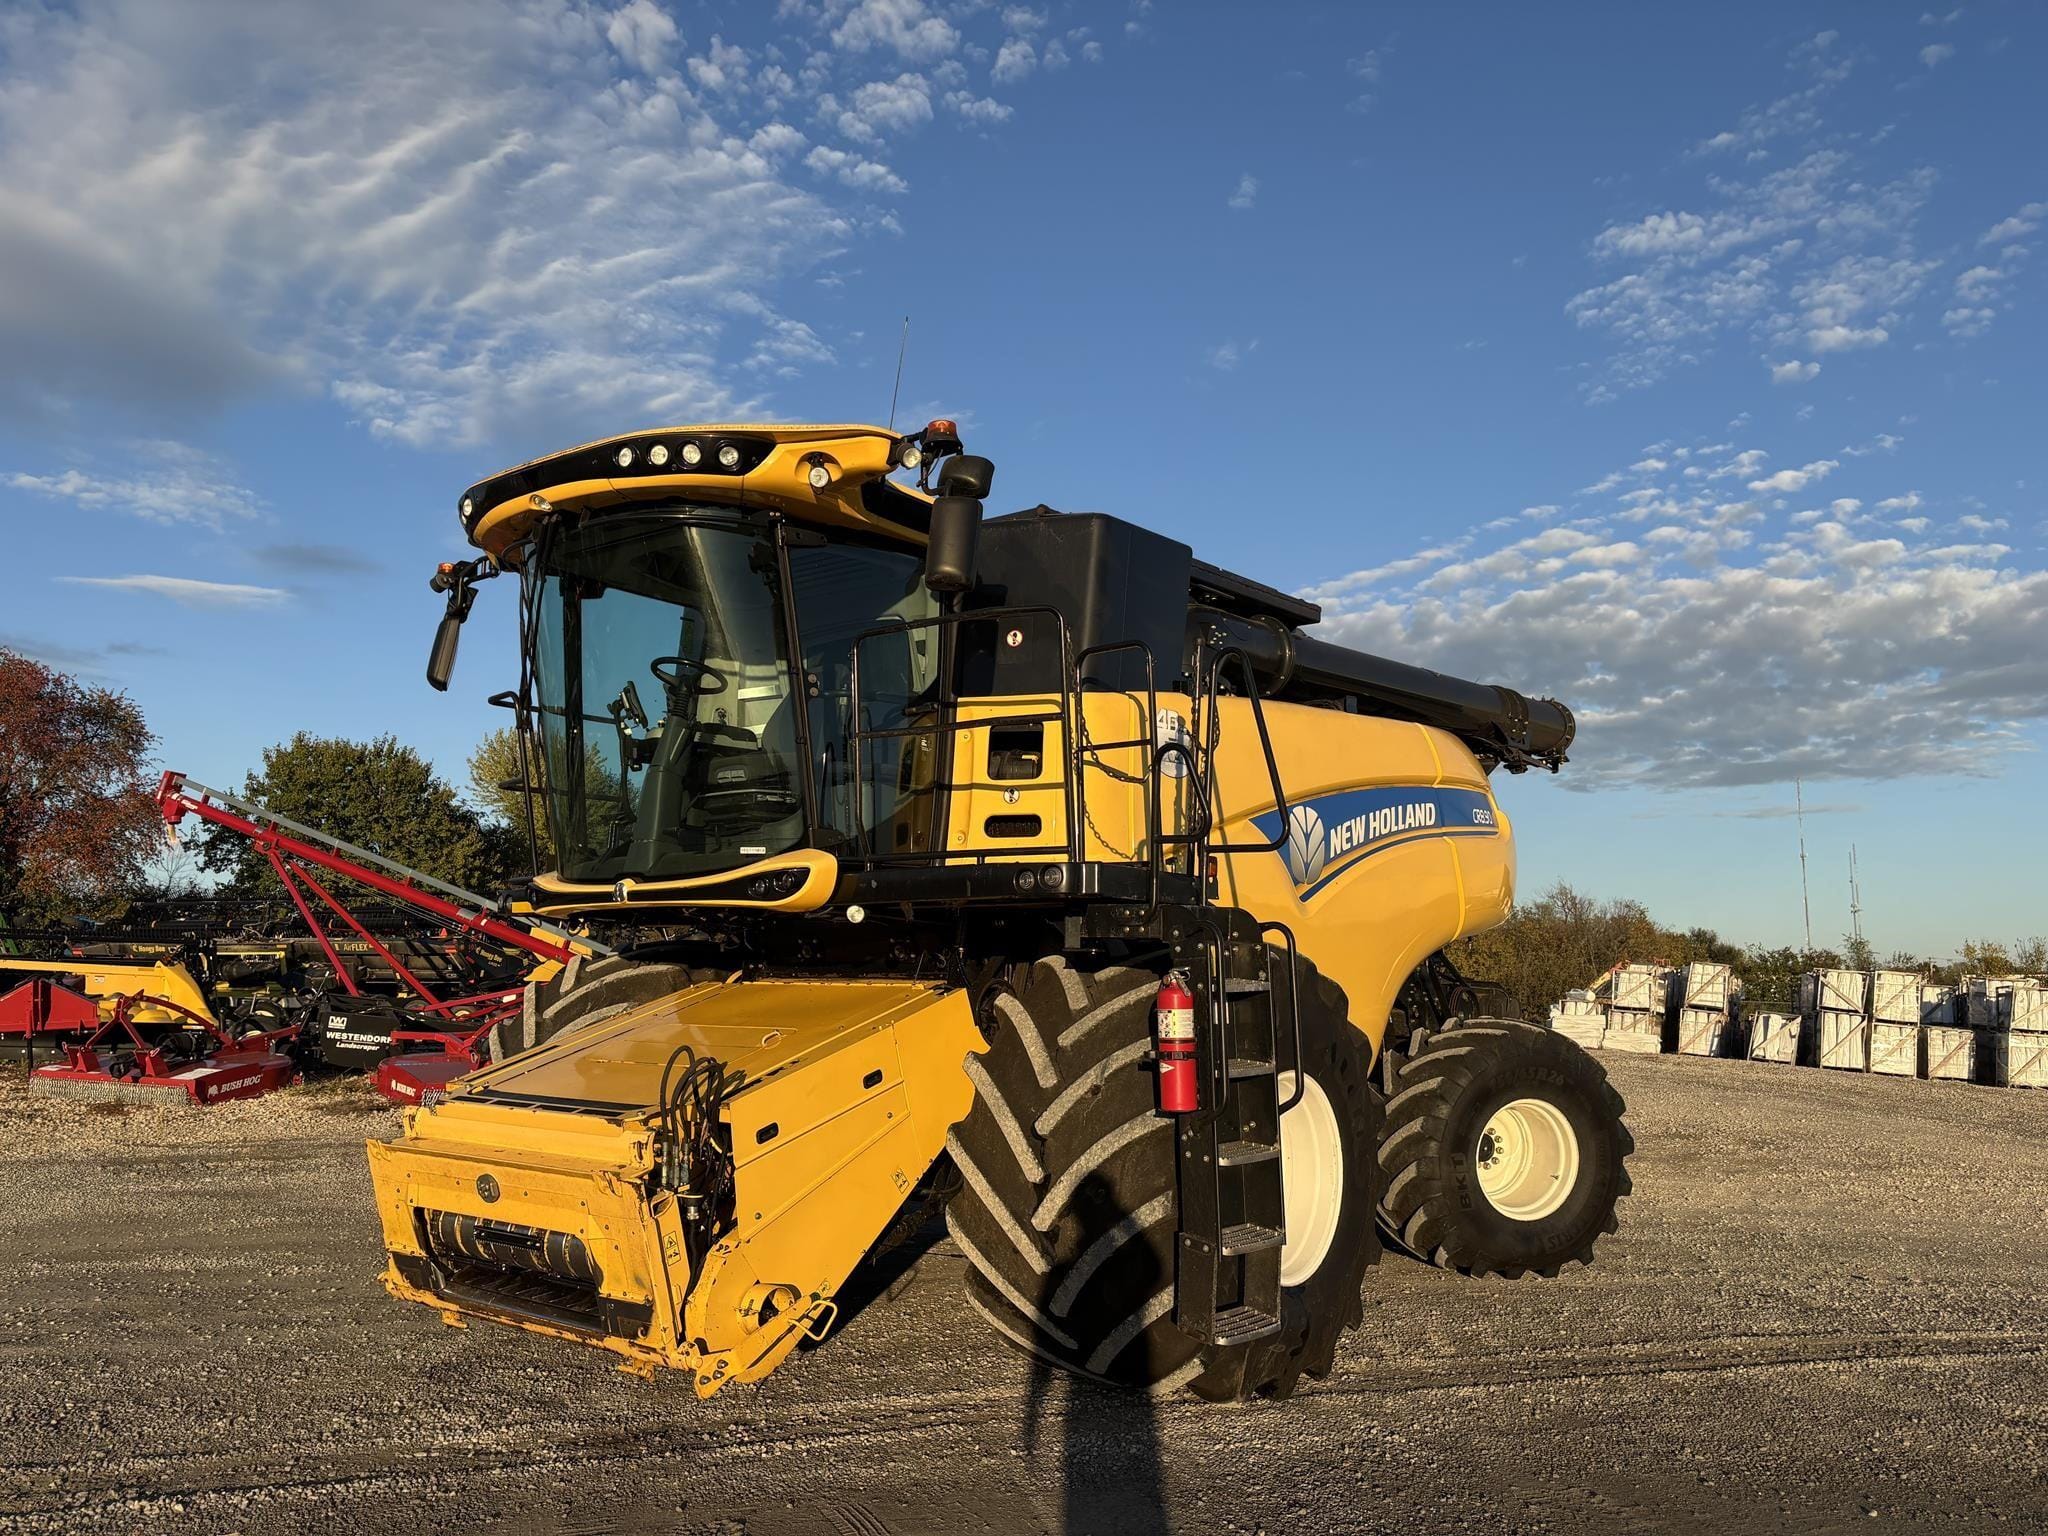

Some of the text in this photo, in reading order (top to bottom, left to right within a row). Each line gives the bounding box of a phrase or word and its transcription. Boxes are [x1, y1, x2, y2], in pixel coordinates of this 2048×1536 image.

[1330, 803, 1436, 859] NEW HOLLAND
[220, 1075, 261, 1093] BUSH HOG
[1449, 1152, 1474, 1213] BKT
